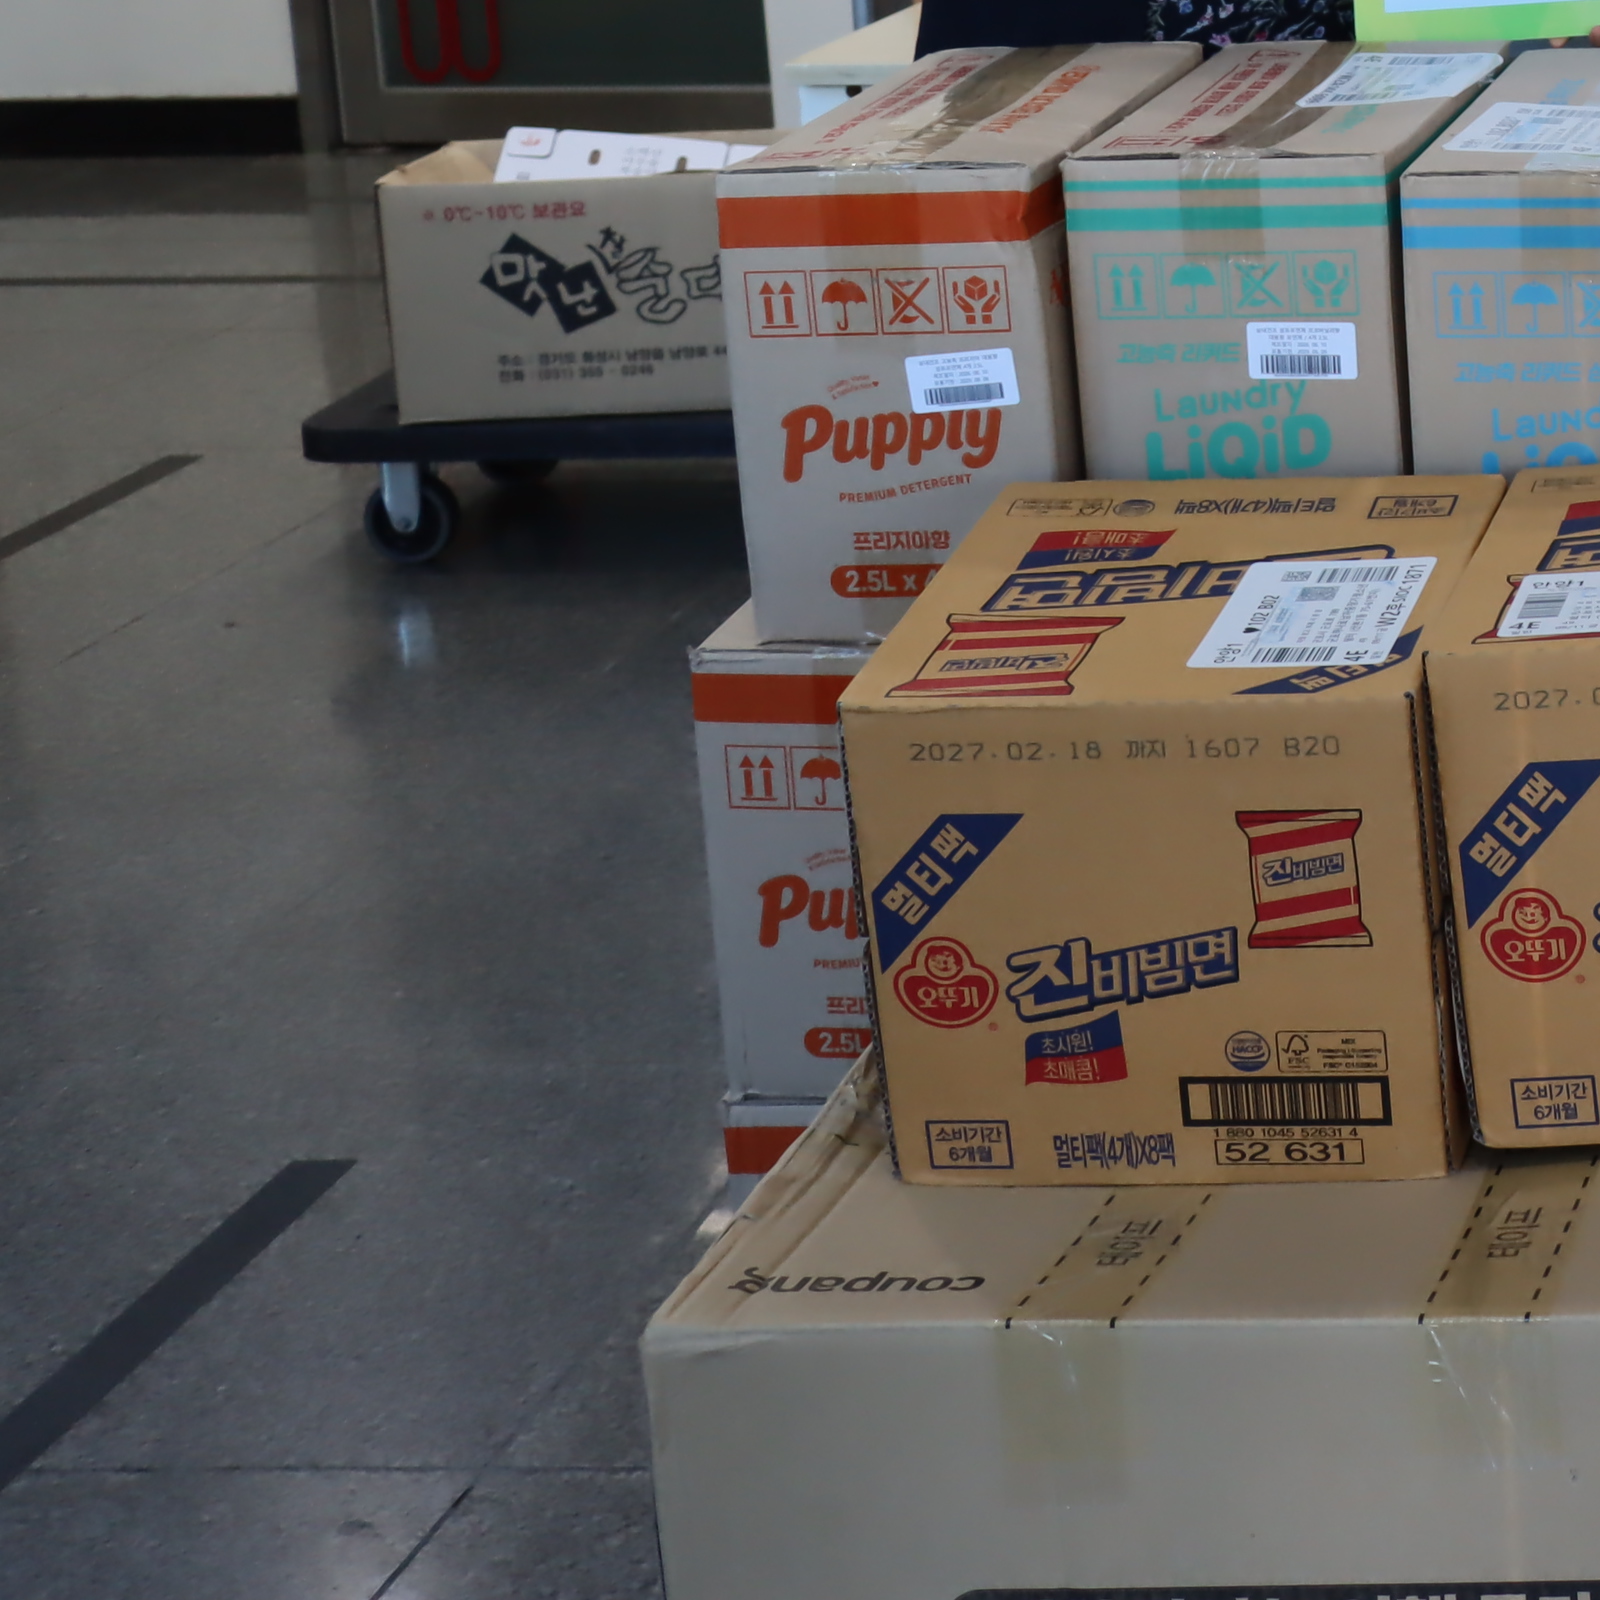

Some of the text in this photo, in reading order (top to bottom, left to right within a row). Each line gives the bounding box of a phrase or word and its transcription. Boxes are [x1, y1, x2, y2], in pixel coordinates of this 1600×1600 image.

[838, 473, 973, 504] PREMIUM DETERGENT
[852, 528, 950, 551] 프리지아향
[844, 568, 898, 595] 2.5L
[908, 735, 1341, 764] 2027.02.18 까지 1607 B20
[1469, 770, 1568, 875] 멀티팩
[880, 822, 982, 925] 멀티팩
[1262, 853, 1346, 887] 진비빔면
[1503, 938, 1567, 964] 오뚜기
[1006, 925, 1240, 1022] 진비빔면
[917, 985, 982, 1012] 오뚜기
[1041, 1031, 1094, 1055] 초시원!
[1042, 1056, 1100, 1082] 초매콤!
[1519, 1083, 1589, 1104] 소비기간
[1533, 1101, 1580, 1121] 6개월
[935, 1125, 1003, 1146] 소비기간
[1261, 1128, 1296, 1138] 1045
[1300, 1127, 1344, 1138] 52631
[948, 1144, 994, 1165] 6개월
[1224, 1141, 1347, 1162] 52 631
[728, 1264, 987, 1300] coupang
